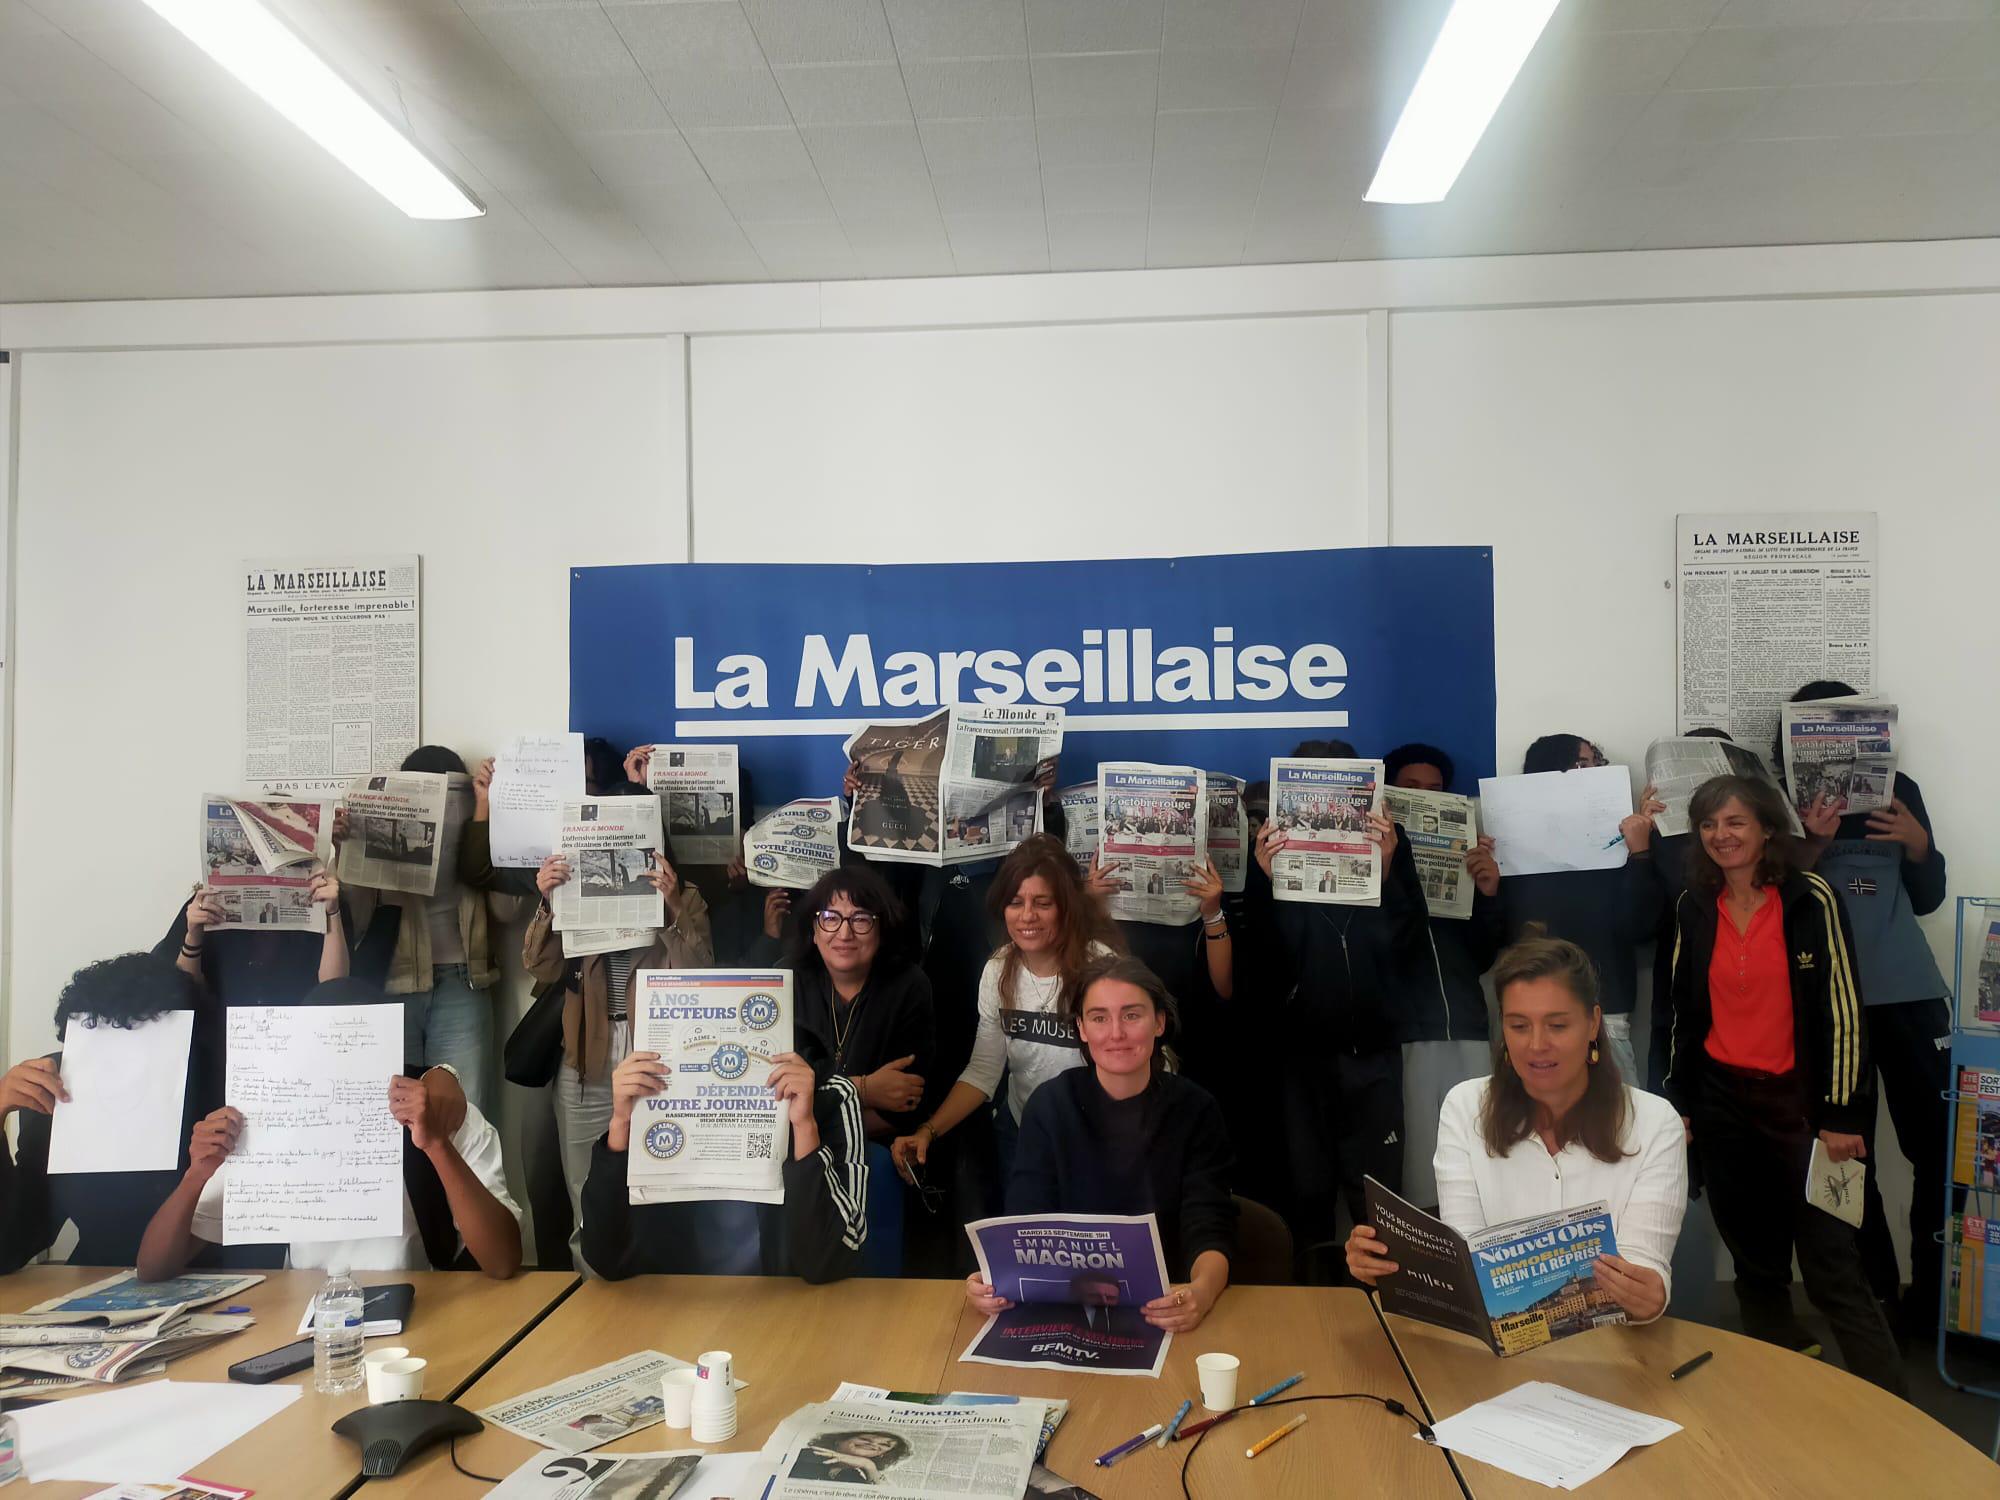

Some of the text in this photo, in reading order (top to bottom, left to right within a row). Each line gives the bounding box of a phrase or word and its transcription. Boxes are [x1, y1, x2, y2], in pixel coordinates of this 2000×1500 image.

[1694, 531, 1860, 546] LA MARSEILLAISE
[247, 570, 386, 591] LA MARSEILLAISE
[248, 604, 296, 614] Marseille,
[300, 603, 350, 612] forteresse
[355, 600, 409, 612] imprenable
[674, 627, 1349, 710] La Marseillaise
[983, 708, 1037, 720] Le Monde
[957, 723, 963, 731] La
[964, 725, 982, 733] France
[1033, 727, 1057, 735] Palestine
[870, 736, 939, 750] TIGER
[1115, 776, 1186, 787] La Marseillaise
[1288, 770, 1363, 781] La Marseillaise
[383, 795, 409, 803] MONDE
[1110, 796, 1191, 810] 2 octobre rouge
[1282, 791, 1367, 806] 2 octobre rouge
[220, 807, 232, 816] La
[396, 811, 416, 819] morts
[562, 825, 591, 833] FRANCE
[753, 844, 835, 860] VOTRE JOURNAL
[649, 992, 700, 1006] À NOS
[649, 1007, 737, 1019] LECTEURS
[754, 1007, 765, 1017] M
[724, 1056, 736, 1066] M
[646, 1099, 777, 1111] VOTRE JOURNAL
[653, 1123, 676, 1132] J'AIME
[659, 1135, 670, 1146] M
[1375, 1201, 1396, 1222] VOUS
[1396, 1217, 1455, 1248] RECHERCHEZ
[1376, 1214, 1386, 1226] LA
[1052, 1230, 1093, 1238] SEPTEMBRE
[1013, 1238, 1121, 1252] EMMANUEL
[1480, 1231, 1555, 1267] Nouvel
[1558, 1220, 1606, 1242] Obs
[1014, 1248, 1125, 1269] MACRON
[1489, 1237, 1601, 1278] IMMOBILIER
[1492, 1244, 1603, 1289] ENFIN LA REPRISE
[1500, 1312, 1544, 1333] Marseille
[1002, 1324, 1072, 1335] INTERVIEW
[830, 1410, 882, 1422] Claudia,
[944, 1416, 1011, 1425] Cardinale
